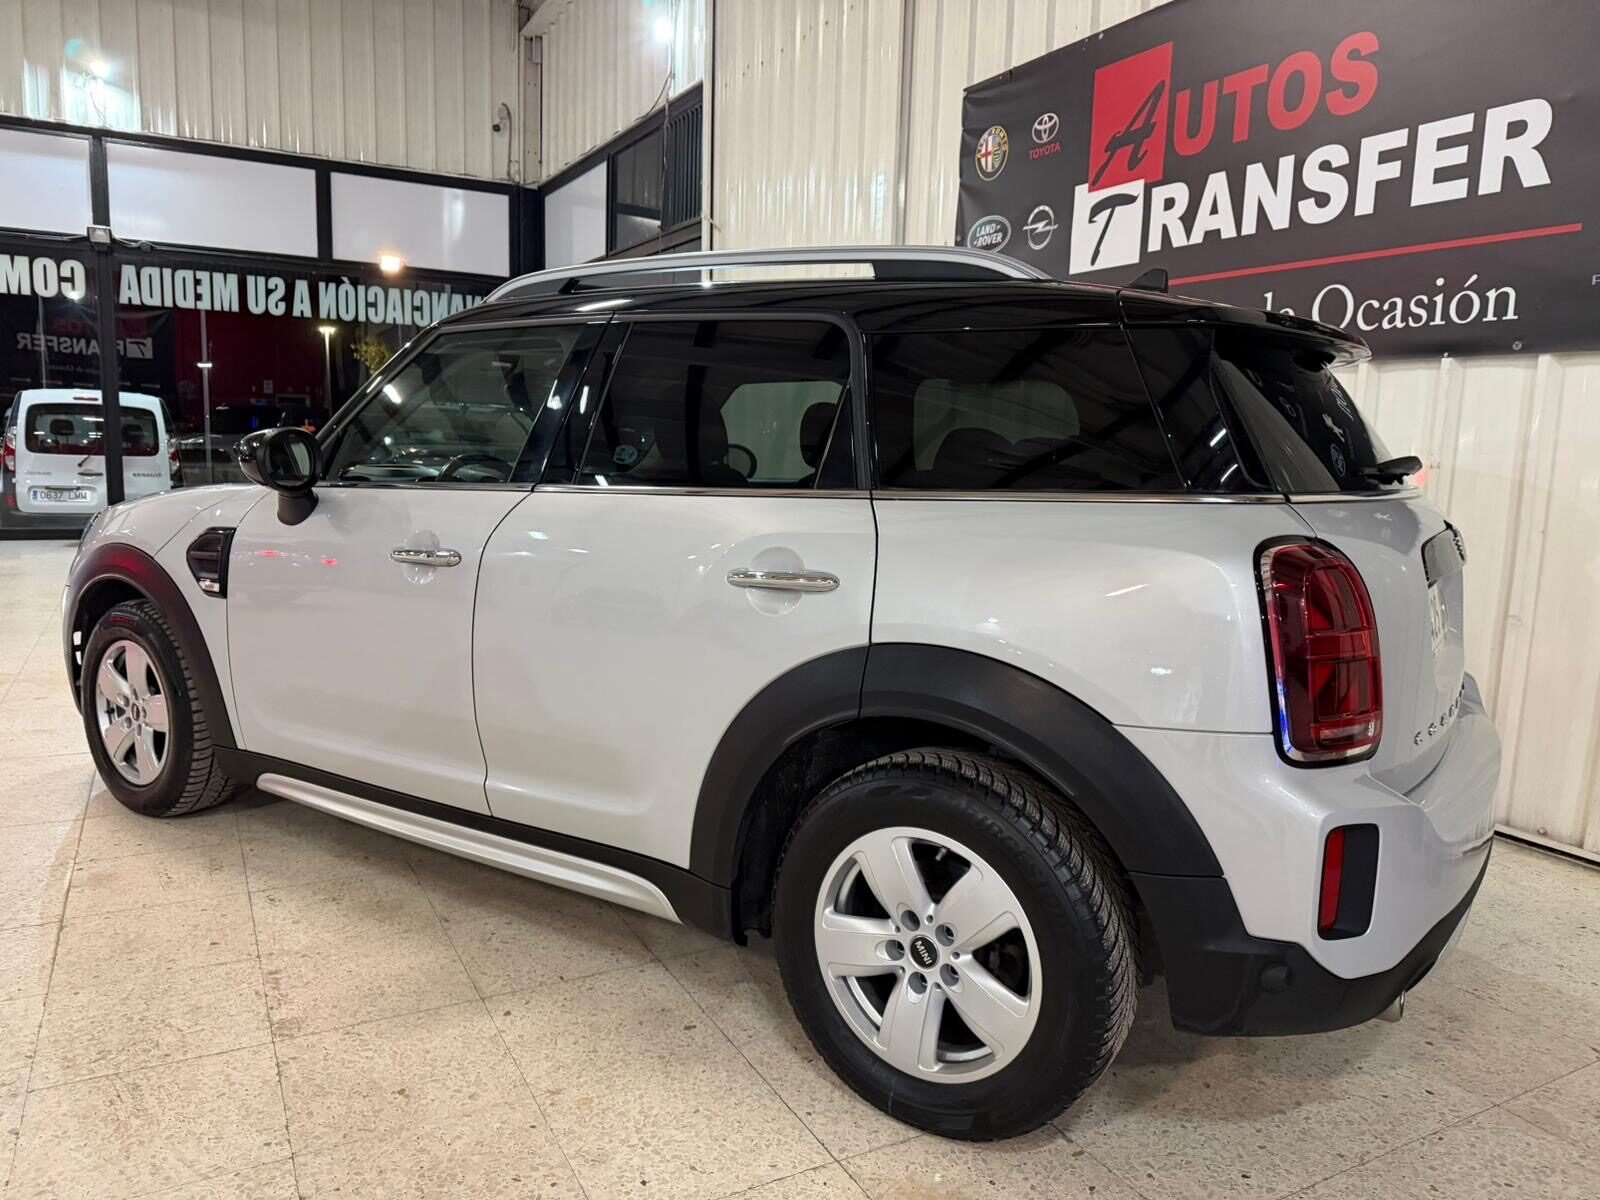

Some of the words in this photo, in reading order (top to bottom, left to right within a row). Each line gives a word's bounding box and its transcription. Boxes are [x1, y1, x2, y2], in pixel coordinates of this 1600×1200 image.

[1090, 31, 1380, 187] AUTOS
[1029, 143, 1061, 159] TOYOTA
[1088, 98, 1552, 267] TRANSFER
[976, 223, 996, 237] LAND
[977, 233, 1003, 248] ROVER
[1312, 273, 1519, 331] Ocasión
[914, 941, 932, 964] MINI
